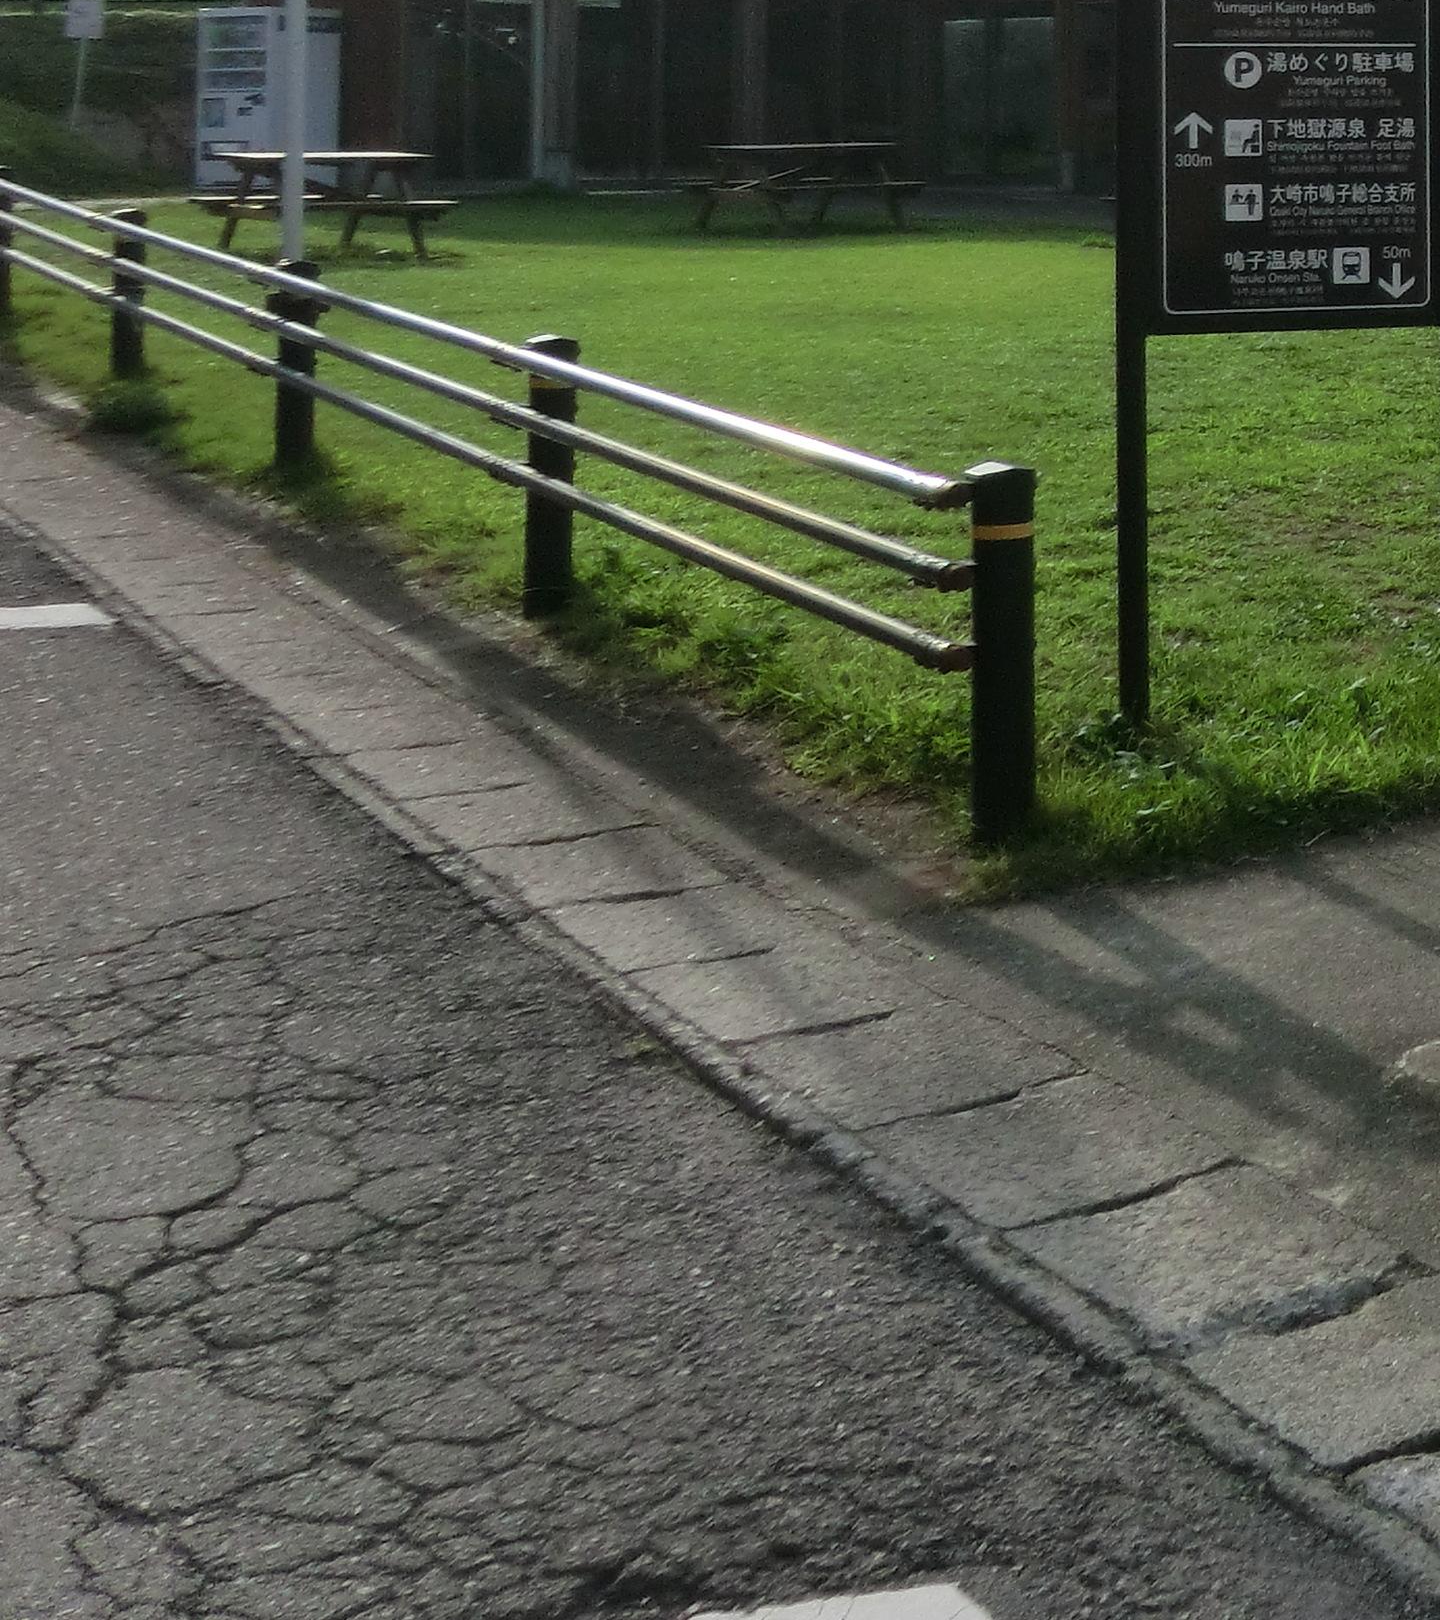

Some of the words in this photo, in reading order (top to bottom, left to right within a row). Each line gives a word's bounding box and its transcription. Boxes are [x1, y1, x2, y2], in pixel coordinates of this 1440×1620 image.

[1214, 1, 1272, 16] Yumeguri
[1275, 2, 1307, 14] Kairo
[1311, 2, 1345, 14] Hand
[1348, 2, 1376, 14] Bath
[1266, 51, 1415, 73] 湯めぐり駐車場
[1346, 75, 1387, 88] Parking
[1267, 118, 1366, 139] 下地獄源泉
[1377, 117, 1415, 139] 足湯
[1174, 153, 1212, 168] 300m
[1269, 182, 1416, 204] 大崎市鳴子総合支所
[1225, 249, 1329, 272] 鳴子温泉駅
[1383, 247, 1412, 259] 50m
